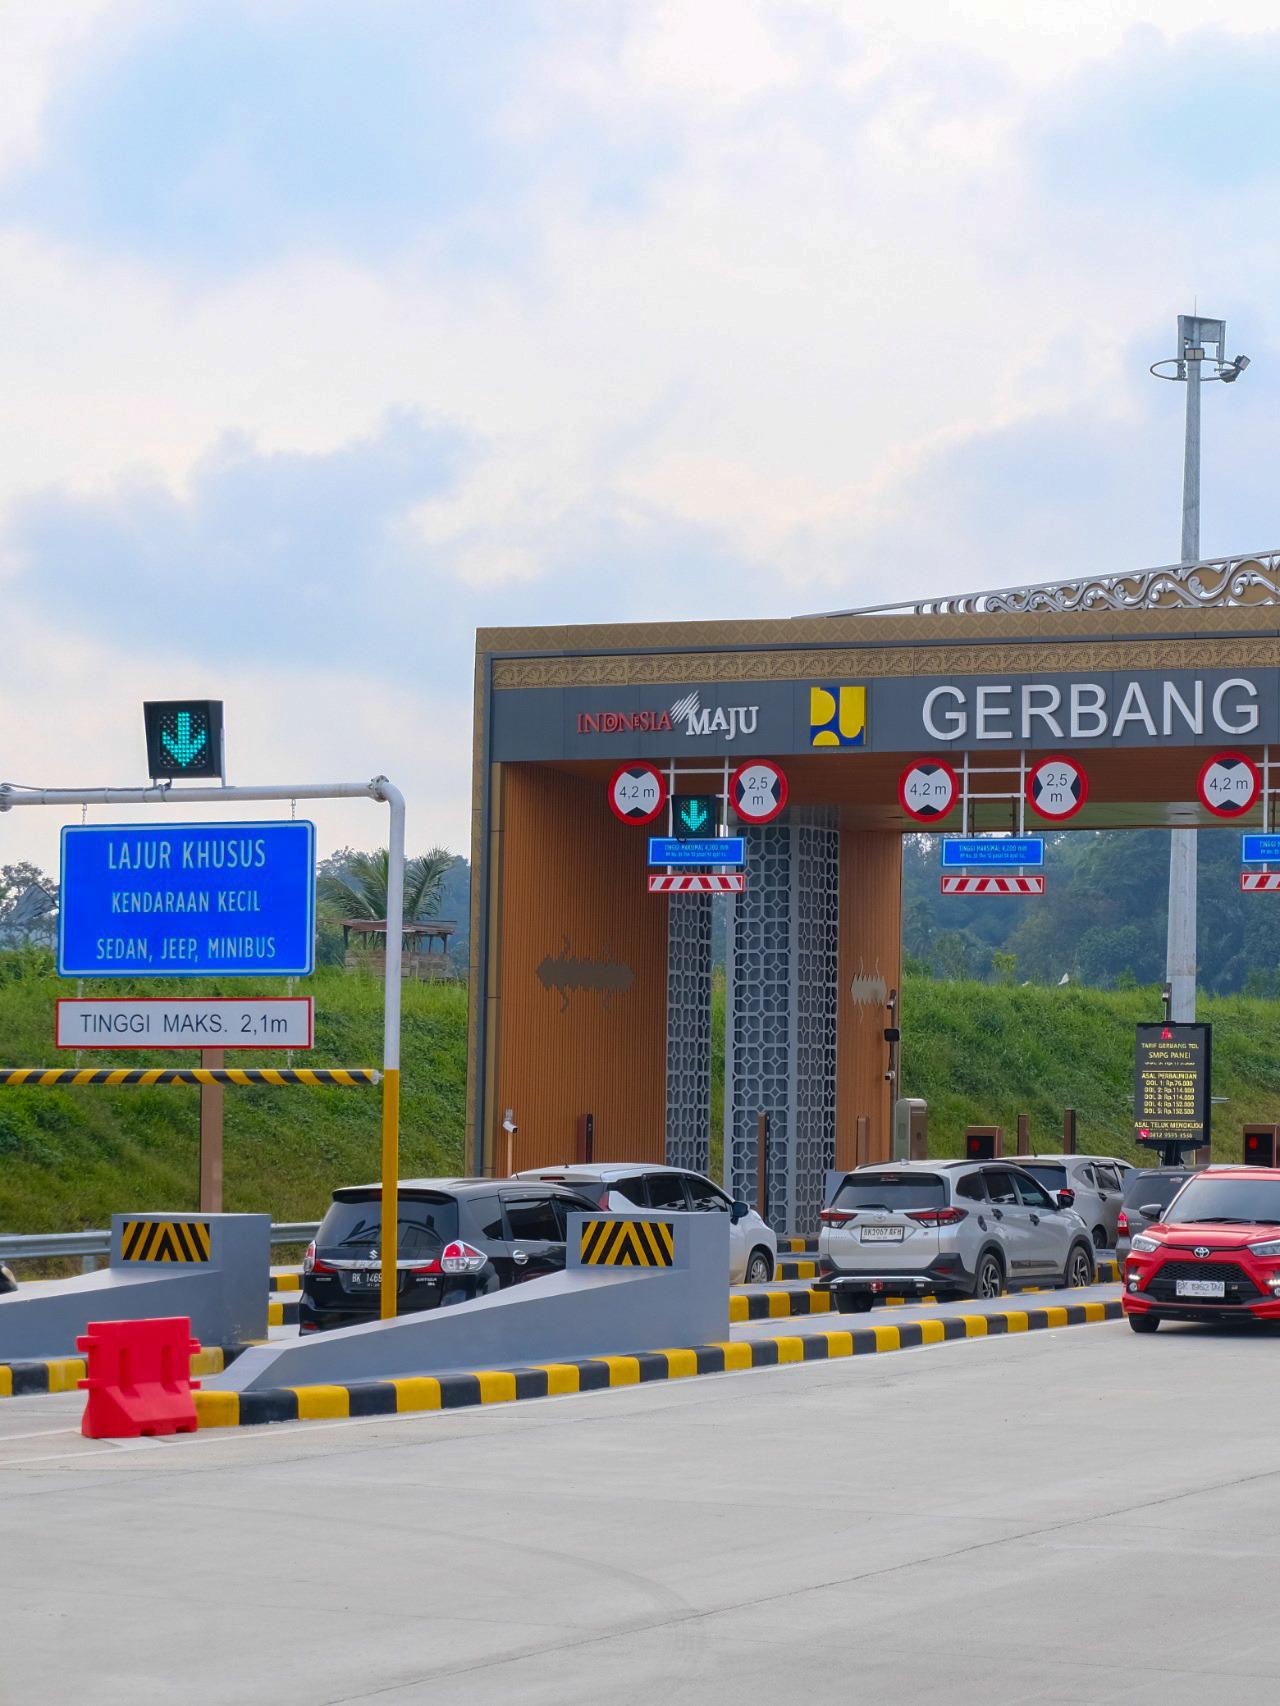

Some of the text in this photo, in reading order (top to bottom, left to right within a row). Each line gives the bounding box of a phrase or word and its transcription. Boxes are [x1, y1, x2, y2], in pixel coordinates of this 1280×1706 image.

[922, 678, 1259, 741] GERBANG
[685, 706, 760, 741] MAJU
[748, 777, 768, 791] 2,5
[1046, 773, 1068, 787] 2,5
[1209, 777, 1248, 791] 4,2 m
[619, 785, 655, 800] 4,2 m
[910, 783, 947, 797] 4,2 m
[752, 795, 764, 806] m
[1050, 792, 1063, 803] m
[108, 839, 266, 870] LAJUR KHUSUS
[112, 890, 261, 914] KENDARAAN KECIL
[96, 936, 276, 963] SEDAN, JEEP, MINIBUS
[80, 1013, 288, 1035] TINGGI MAKS. 2,1m
[1148, 1051, 1191, 1059] SMPG PANEI
[352, 1273, 361, 1283] BK
